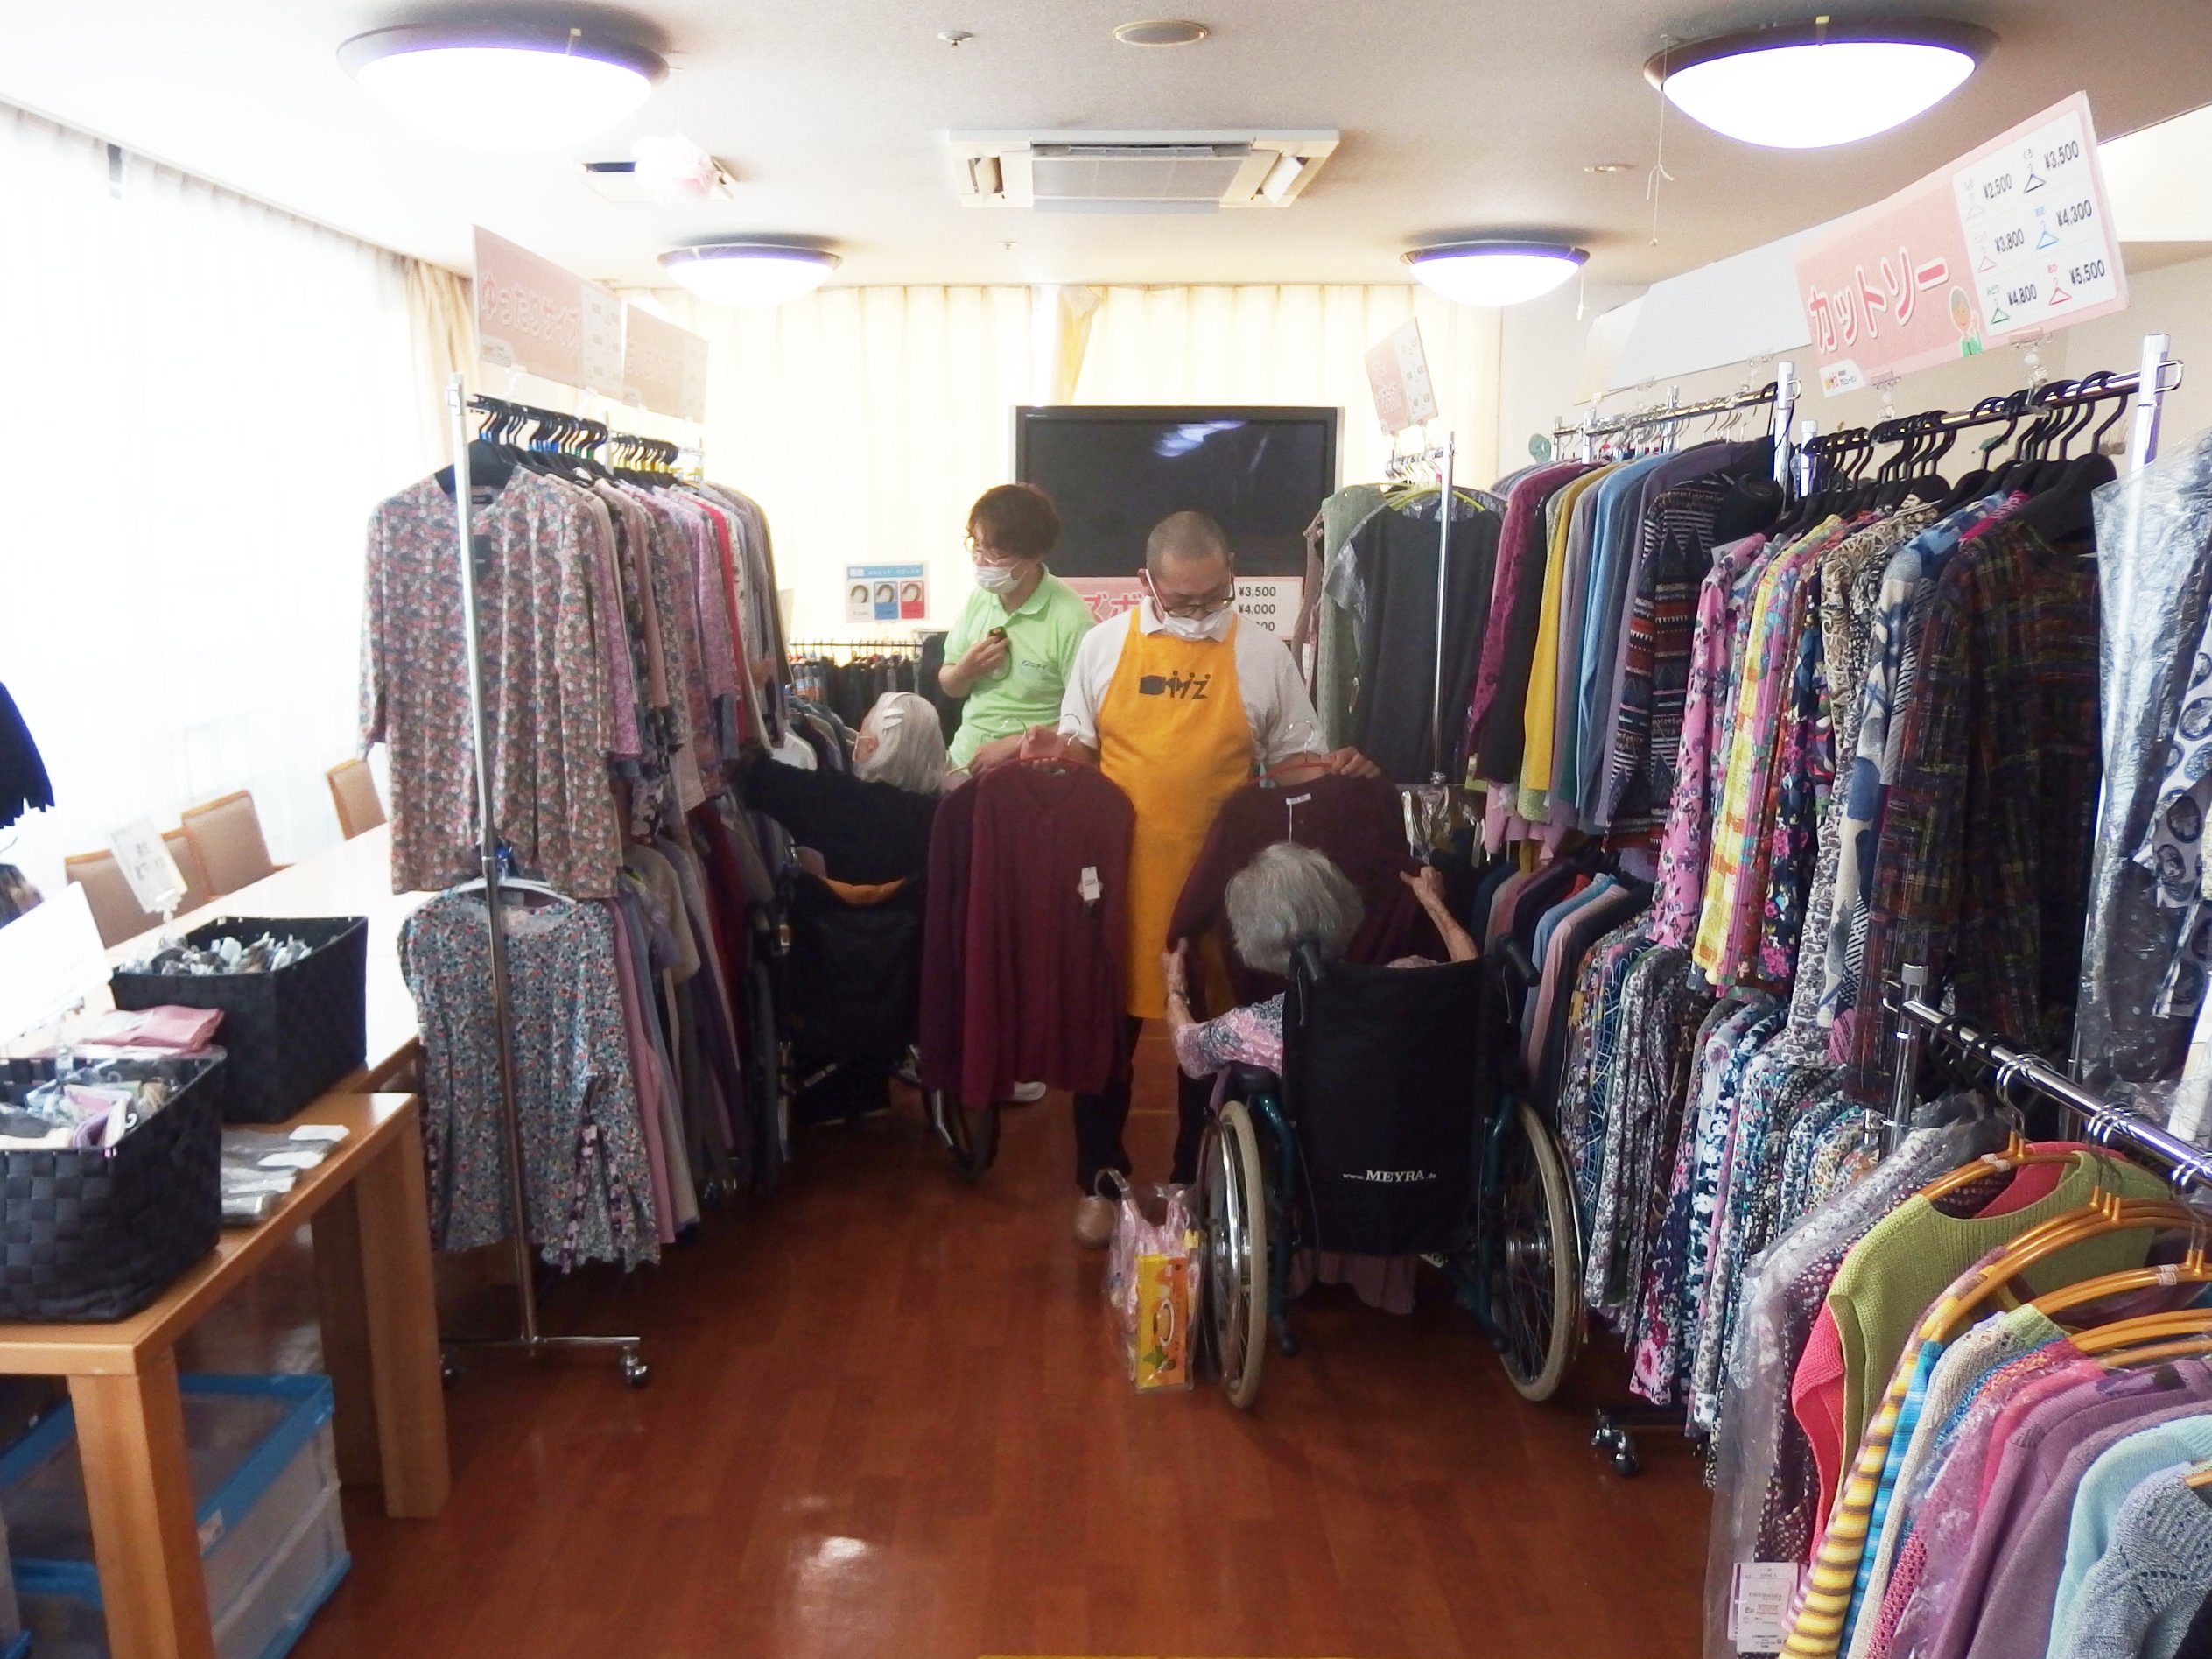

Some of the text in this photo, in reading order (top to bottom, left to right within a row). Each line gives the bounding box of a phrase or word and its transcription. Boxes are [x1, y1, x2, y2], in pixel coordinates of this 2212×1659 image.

[2044, 140, 2080, 169] ¥3,500
[1983, 173, 2012, 199] ¥2,500
[2056, 200, 2093, 227] ¥4,300
[1995, 228, 2025, 252] ¥3,800
[2069, 259, 2106, 285] ¥5,500
[1808, 247, 1949, 352] カットソー
[2007, 284, 2038, 306] ¥4,800
[1239, 586, 1276, 597] ¥3,500
[1239, 603, 1276, 615] ¥4,000
